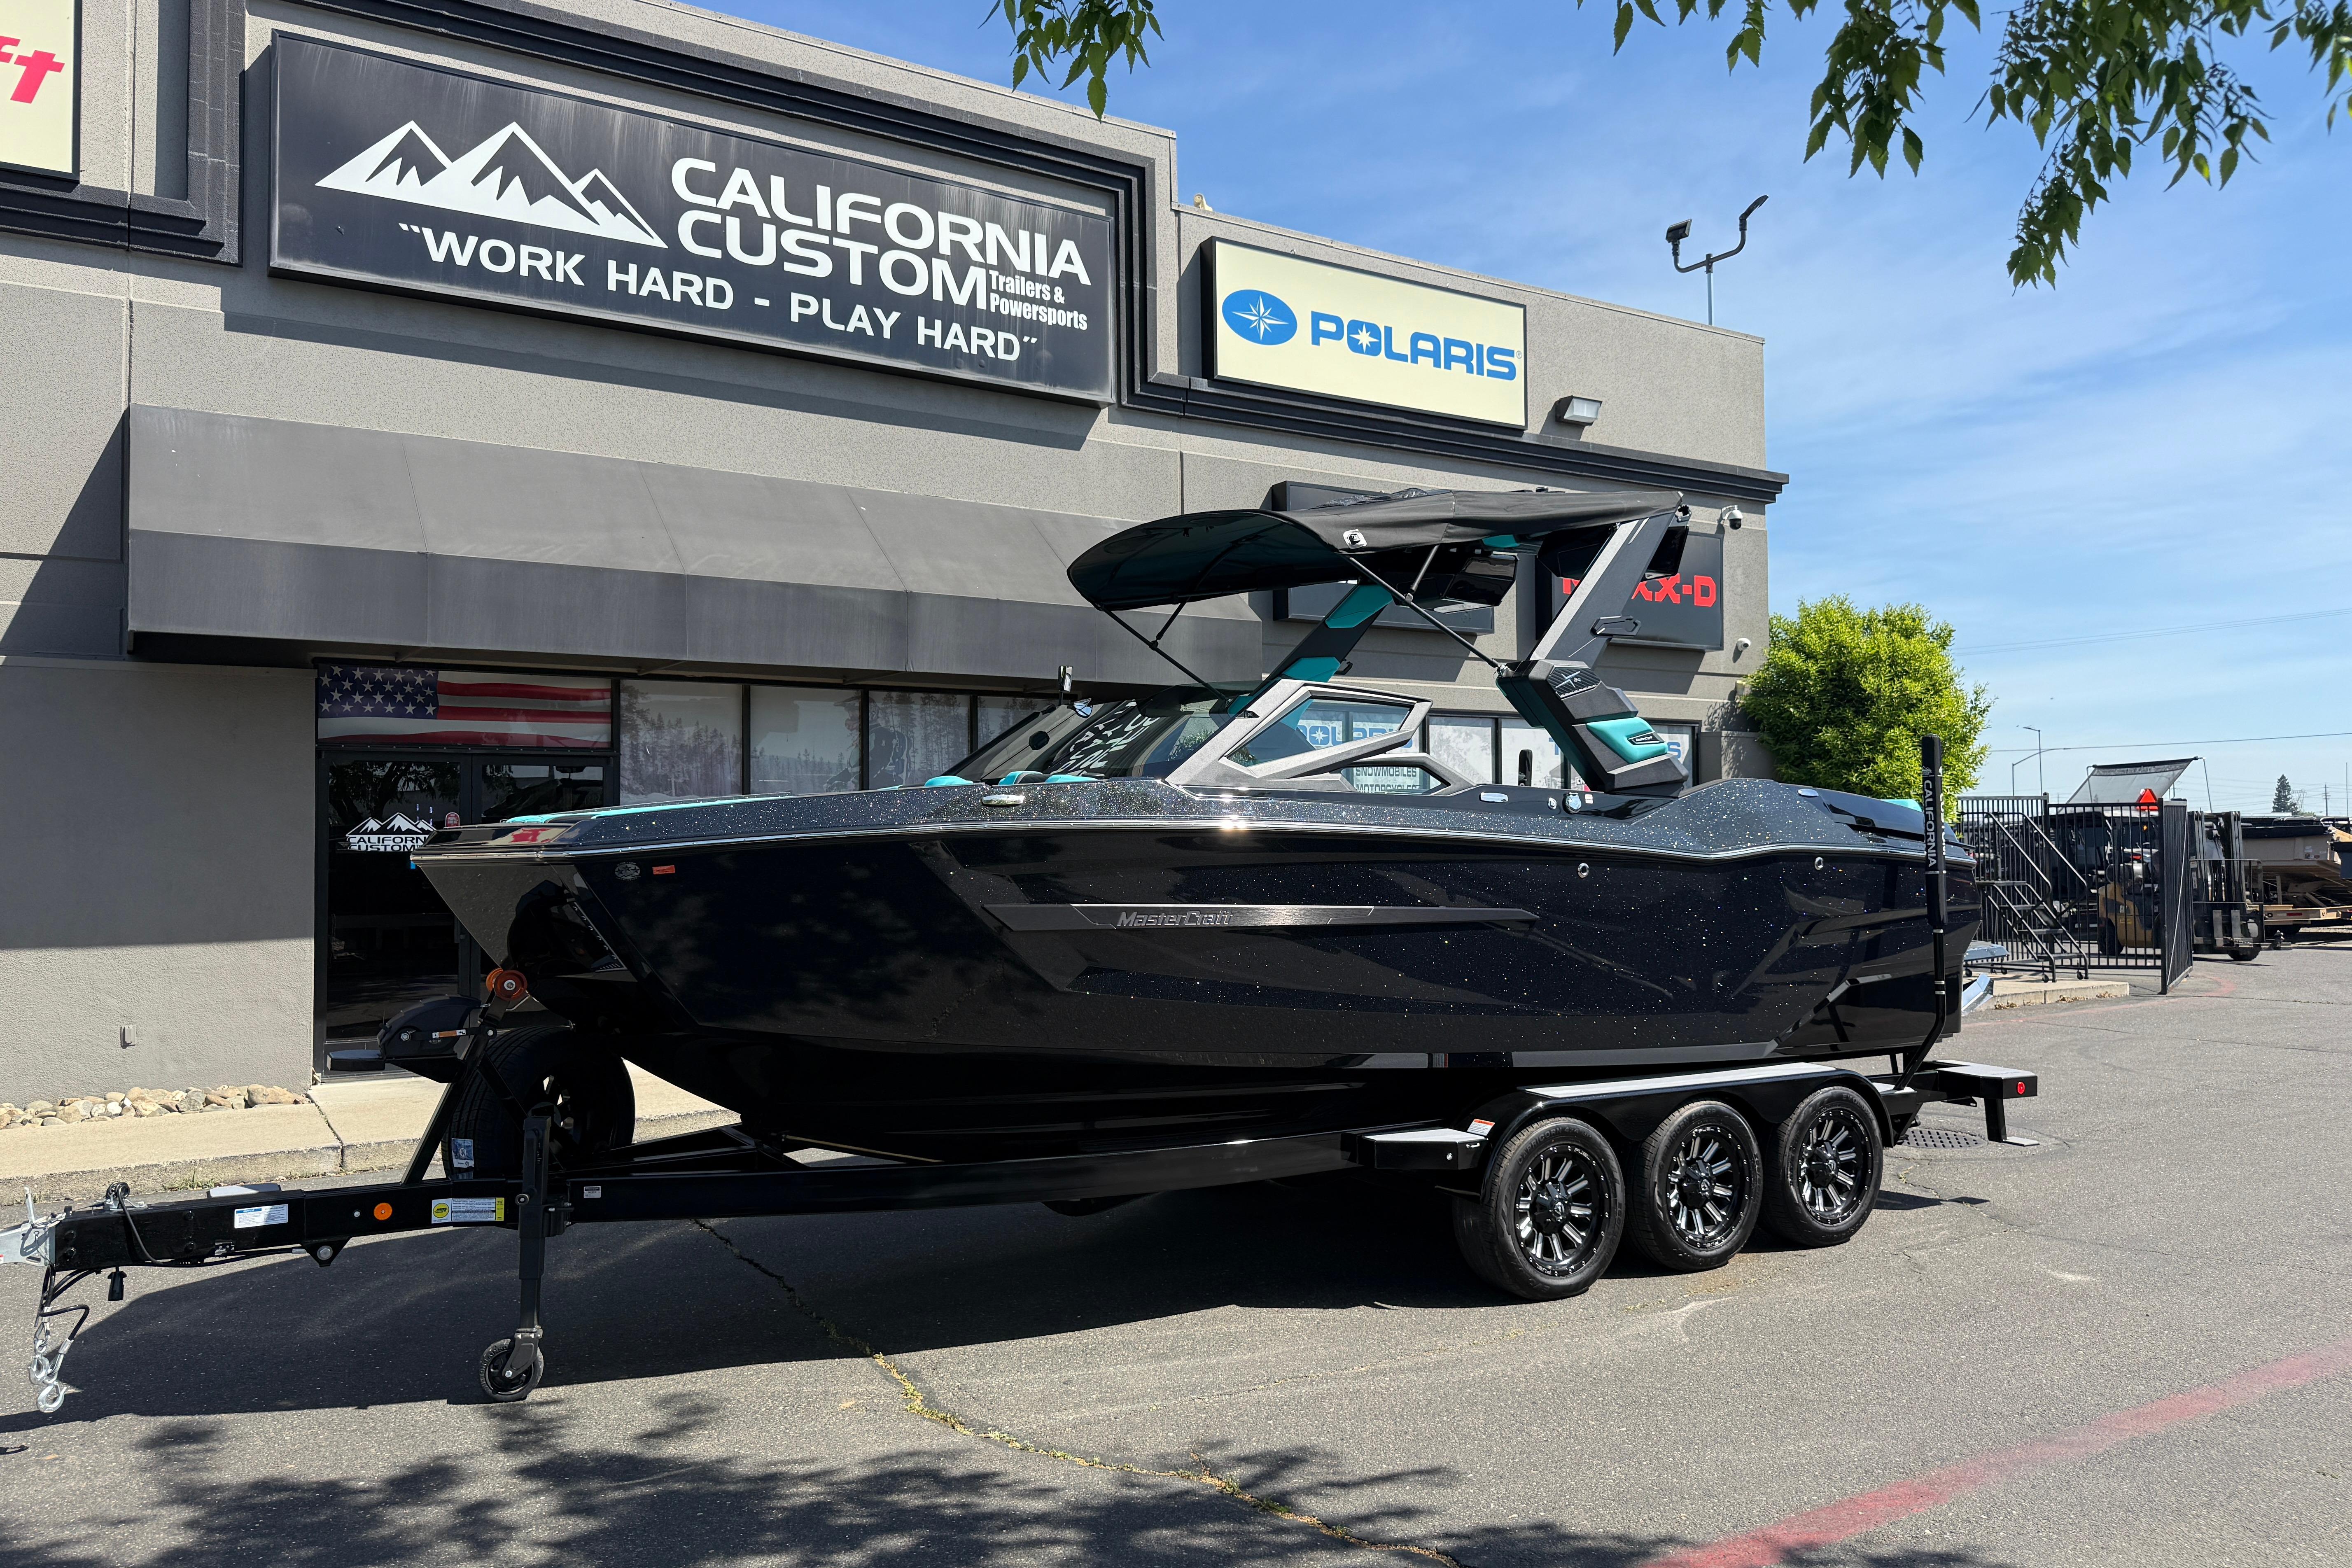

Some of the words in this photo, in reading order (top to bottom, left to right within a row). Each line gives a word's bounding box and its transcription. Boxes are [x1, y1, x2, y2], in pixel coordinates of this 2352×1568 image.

[672, 157, 1091, 285] CALIFORNIA
[678, 210, 987, 310] CUSTOM
[607, 259, 734, 310] HARD
[790, 292, 901, 339] PLAY
[990, 269, 1050, 301] Trailers
[1053, 286, 1066, 304] &
[990, 294, 1088, 331] Powersports
[1311, 310, 1517, 381] POLARIS
[1563, 573, 1716, 607] XX-D
[1356, 766, 1416, 777] SNOWMOBILES
[1924, 779, 1937, 868] CALIFORNIA
[1117, 910, 1233, 926] MasterCraft
[1518, 1127, 1562, 1164] CAPRICORN
[1573, 1147, 1591, 1161] FUEL
